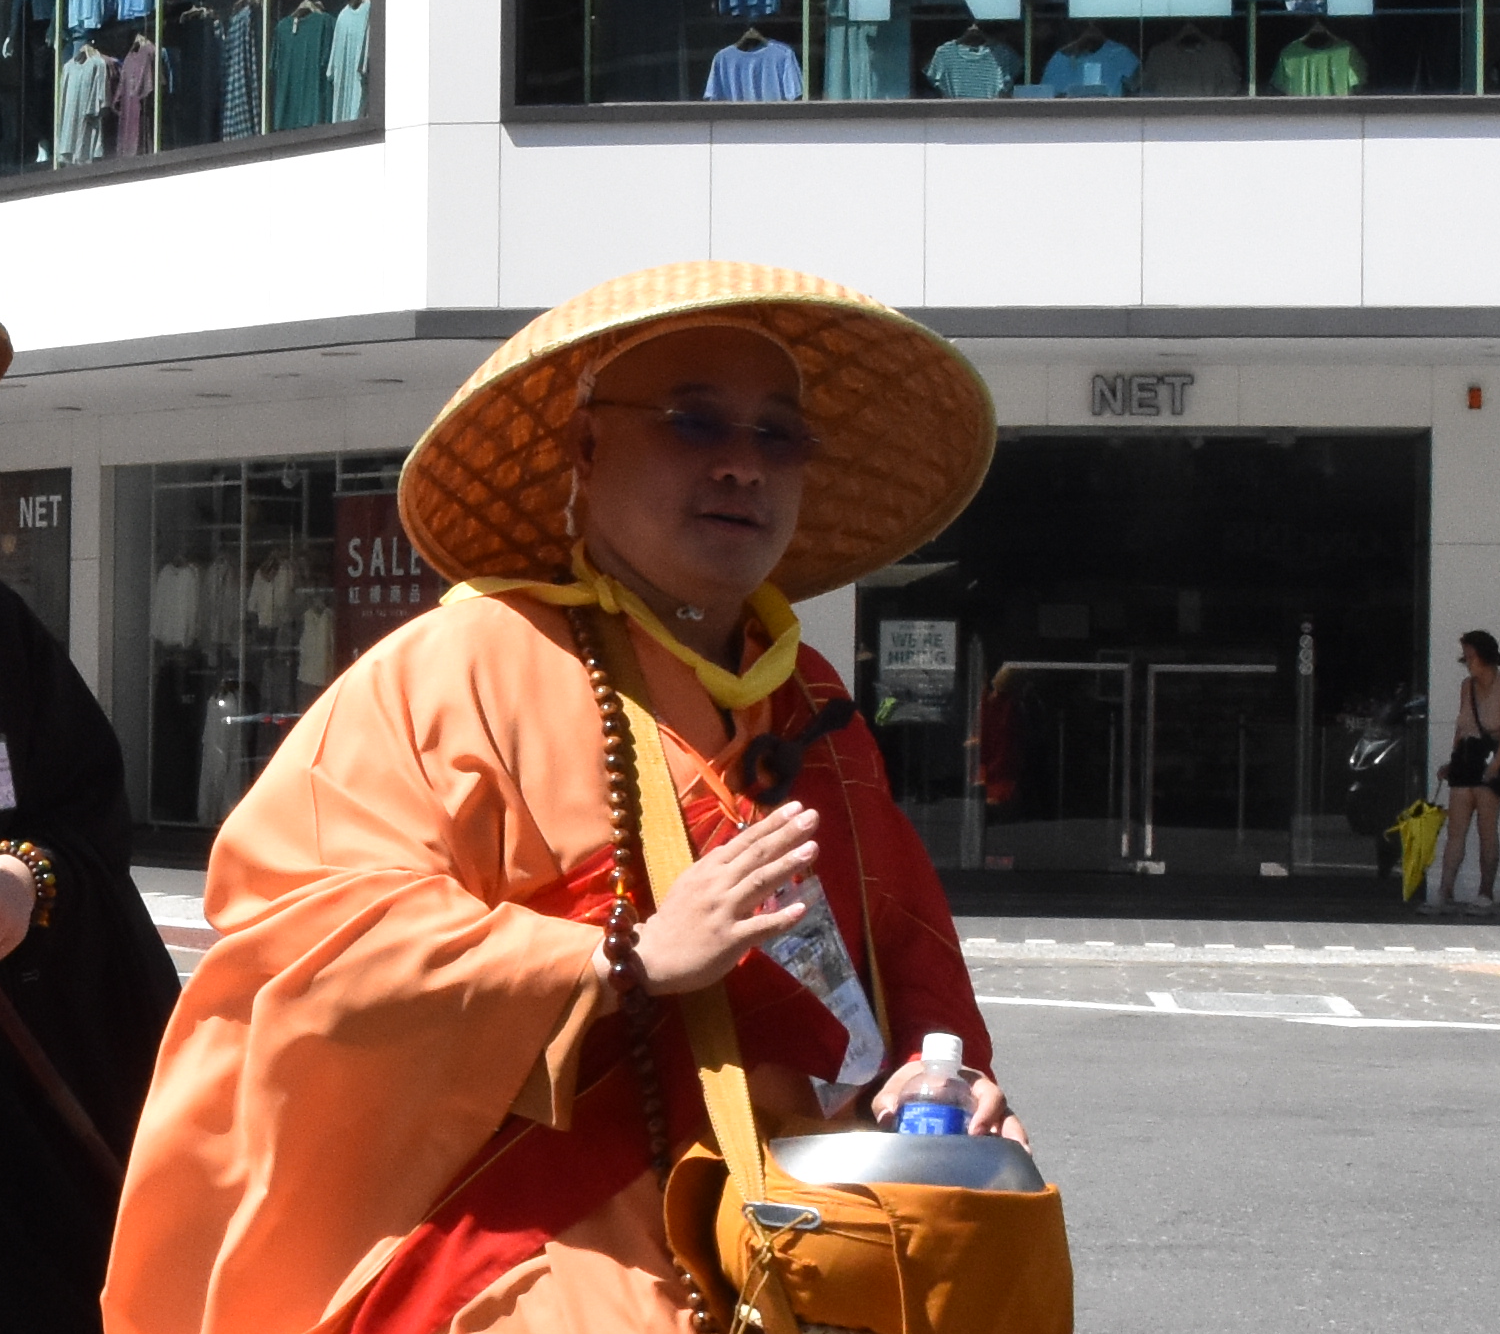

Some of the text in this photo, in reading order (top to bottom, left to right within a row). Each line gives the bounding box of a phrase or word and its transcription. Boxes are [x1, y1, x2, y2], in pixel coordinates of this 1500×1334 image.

[1091, 372, 1194, 417] NET
[18, 495, 63, 530] NET
[347, 536, 422, 578] SALE
[890, 632, 945, 649] WE'RE
